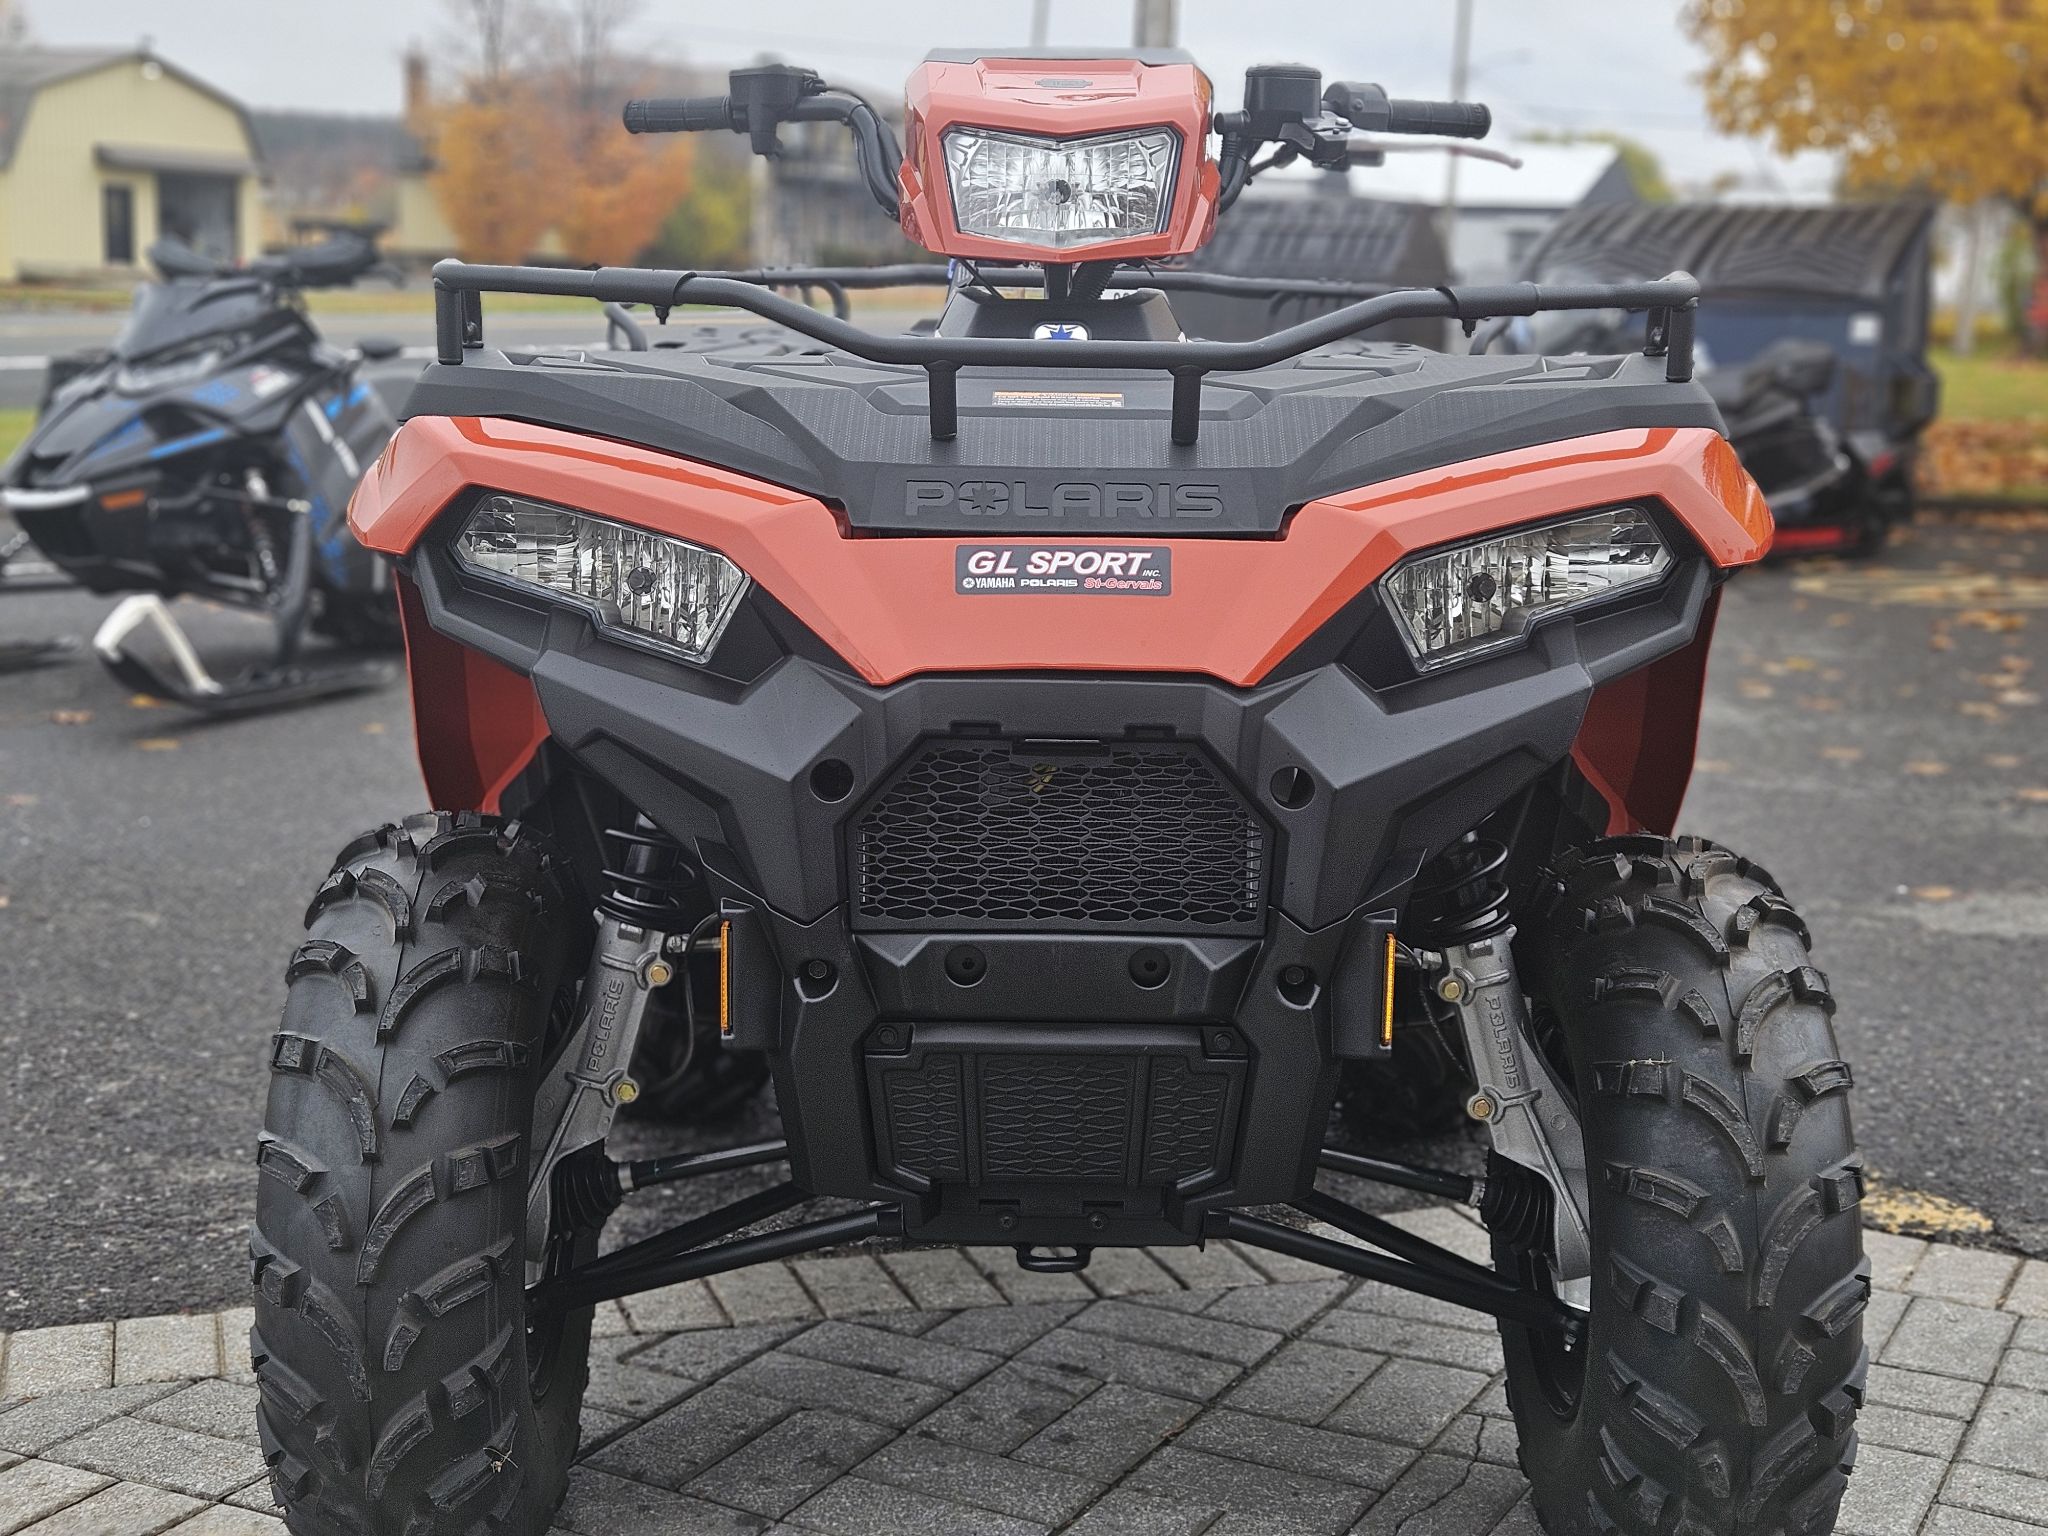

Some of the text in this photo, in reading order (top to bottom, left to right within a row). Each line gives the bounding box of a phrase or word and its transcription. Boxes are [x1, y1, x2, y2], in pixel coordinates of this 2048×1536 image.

[905, 479, 1224, 518] POLARIS
[967, 551, 1019, 575] GL
[1026, 551, 1152, 576] SPORT
[975, 577, 1162, 590] YAMAHA POLARIS St-Gervais
[586, 979, 624, 1072] POLARIS
[1485, 996, 1520, 1089] POLARIS
